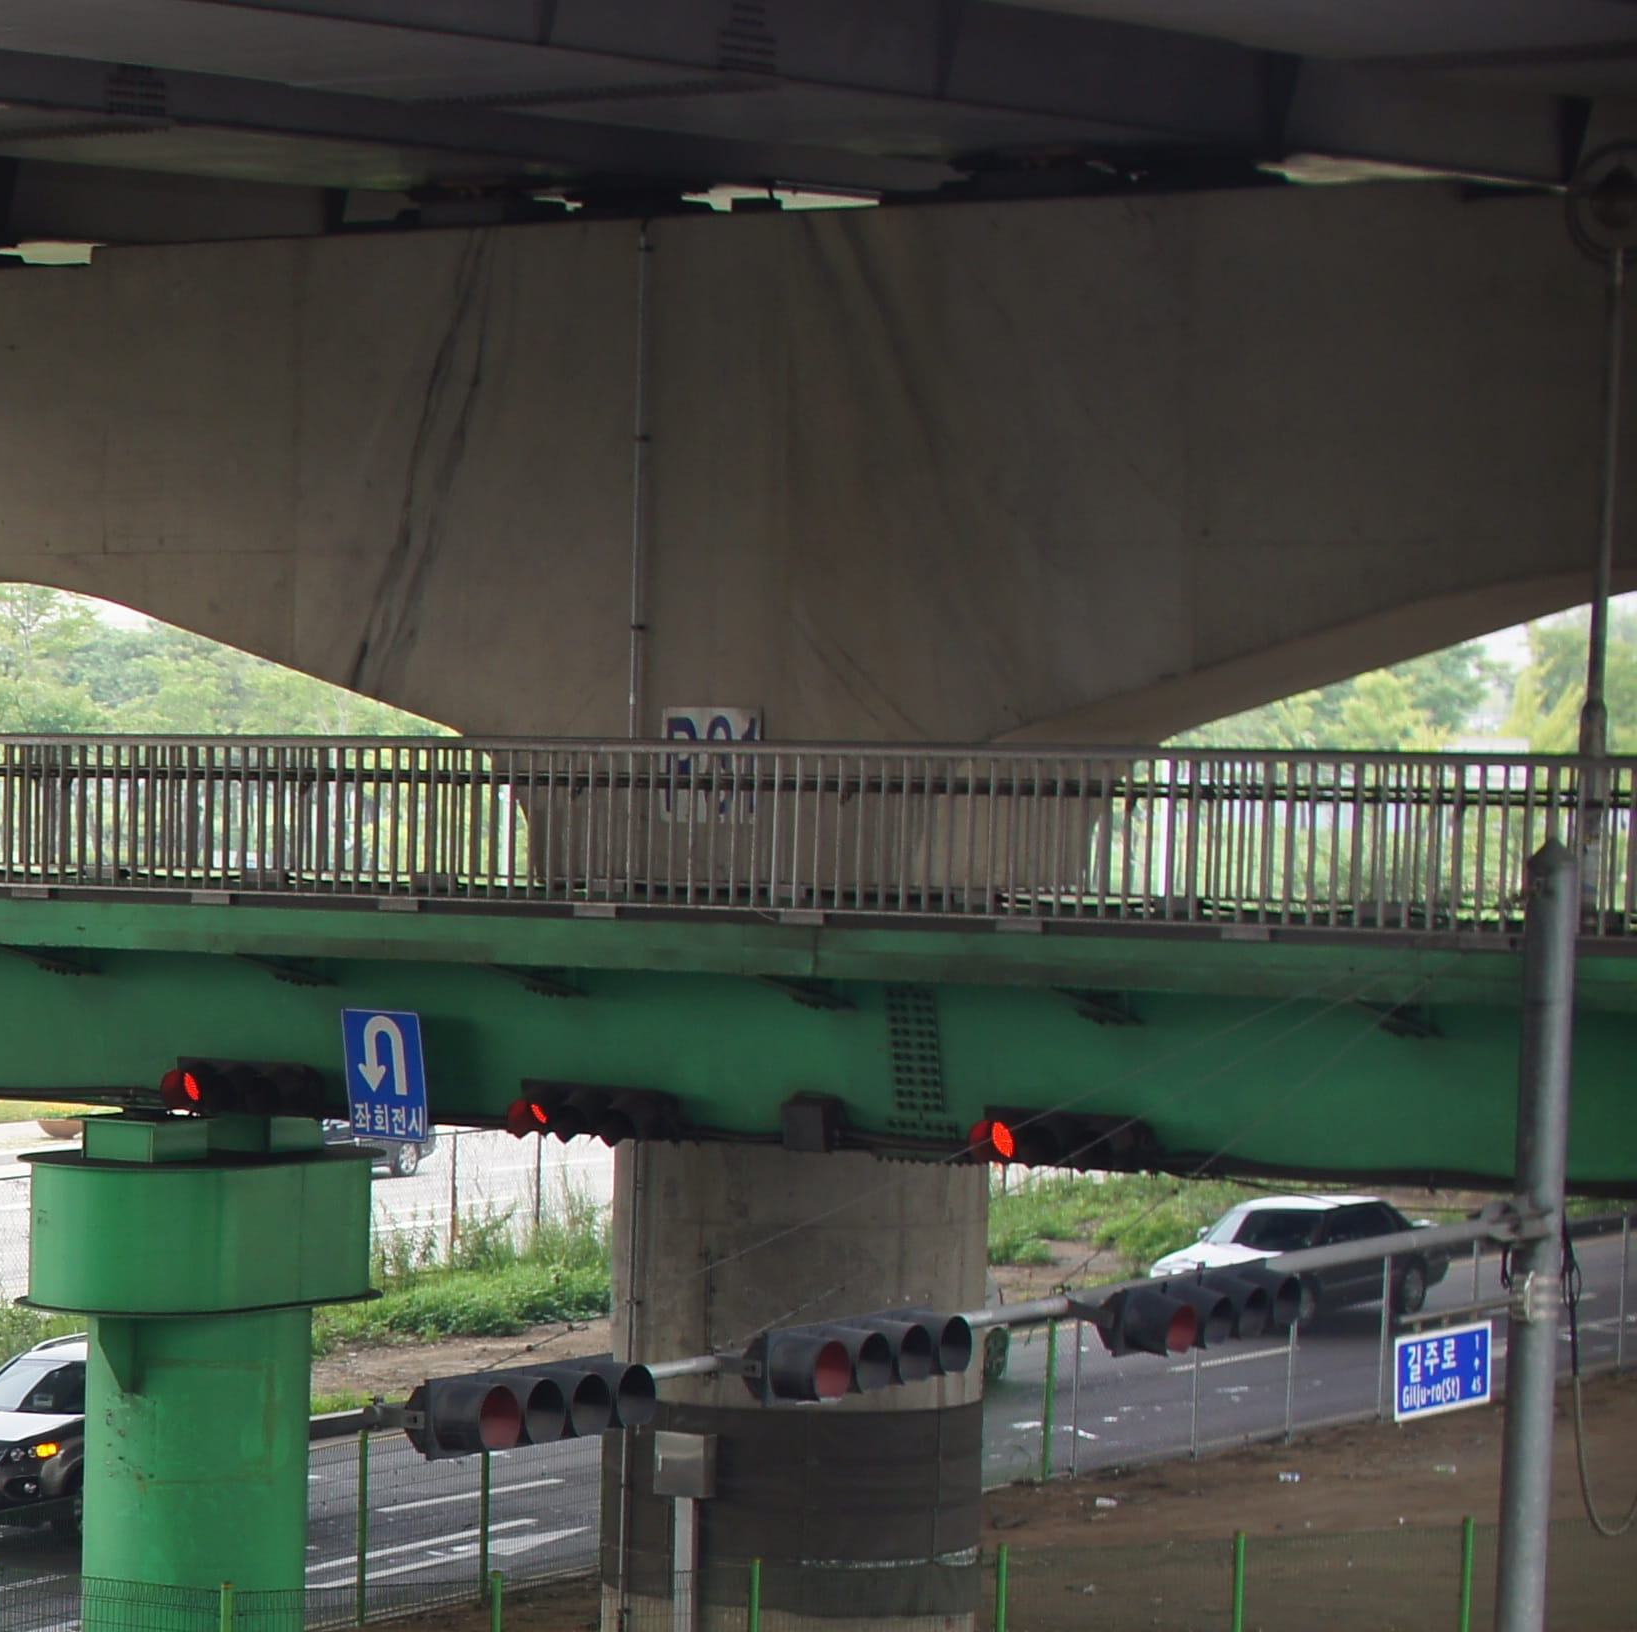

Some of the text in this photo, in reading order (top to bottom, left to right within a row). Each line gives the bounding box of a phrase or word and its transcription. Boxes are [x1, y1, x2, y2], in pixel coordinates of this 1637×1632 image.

[354, 1102, 422, 1137] 좌회전시
[1407, 1338, 1456, 1383] 길주로
[1402, 1376, 1461, 1409] Gilju-ro(St)
